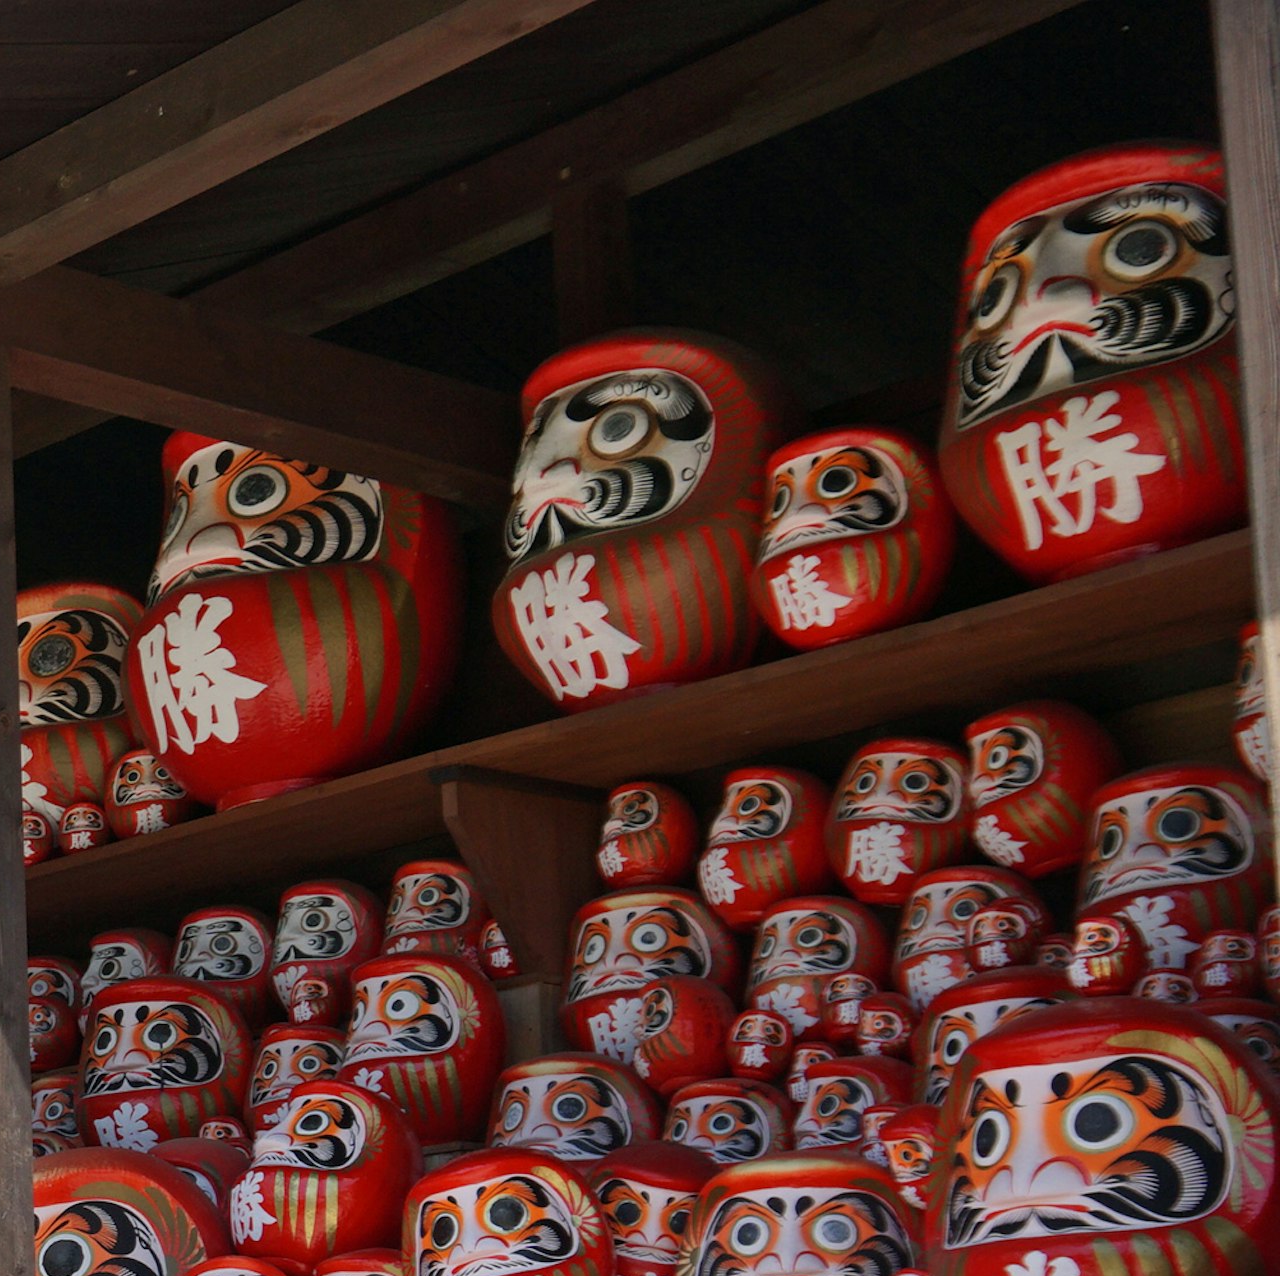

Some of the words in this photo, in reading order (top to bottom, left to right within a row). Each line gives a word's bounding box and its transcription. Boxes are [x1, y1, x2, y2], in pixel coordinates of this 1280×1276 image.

[997, 390, 1166, 551] 勝
[510, 552, 641, 700] 勝
[770, 554, 852, 631] 勝
[138, 593, 268, 755] 勝
[846, 822, 913, 885] 勝
[974, 814, 1028, 867] 勝
[699, 847, 743, 904] 勝
[978, 940, 1008, 968] 勝
[1205, 962, 1232, 987] 勝
[231, 1171, 277, 1243] 勝
